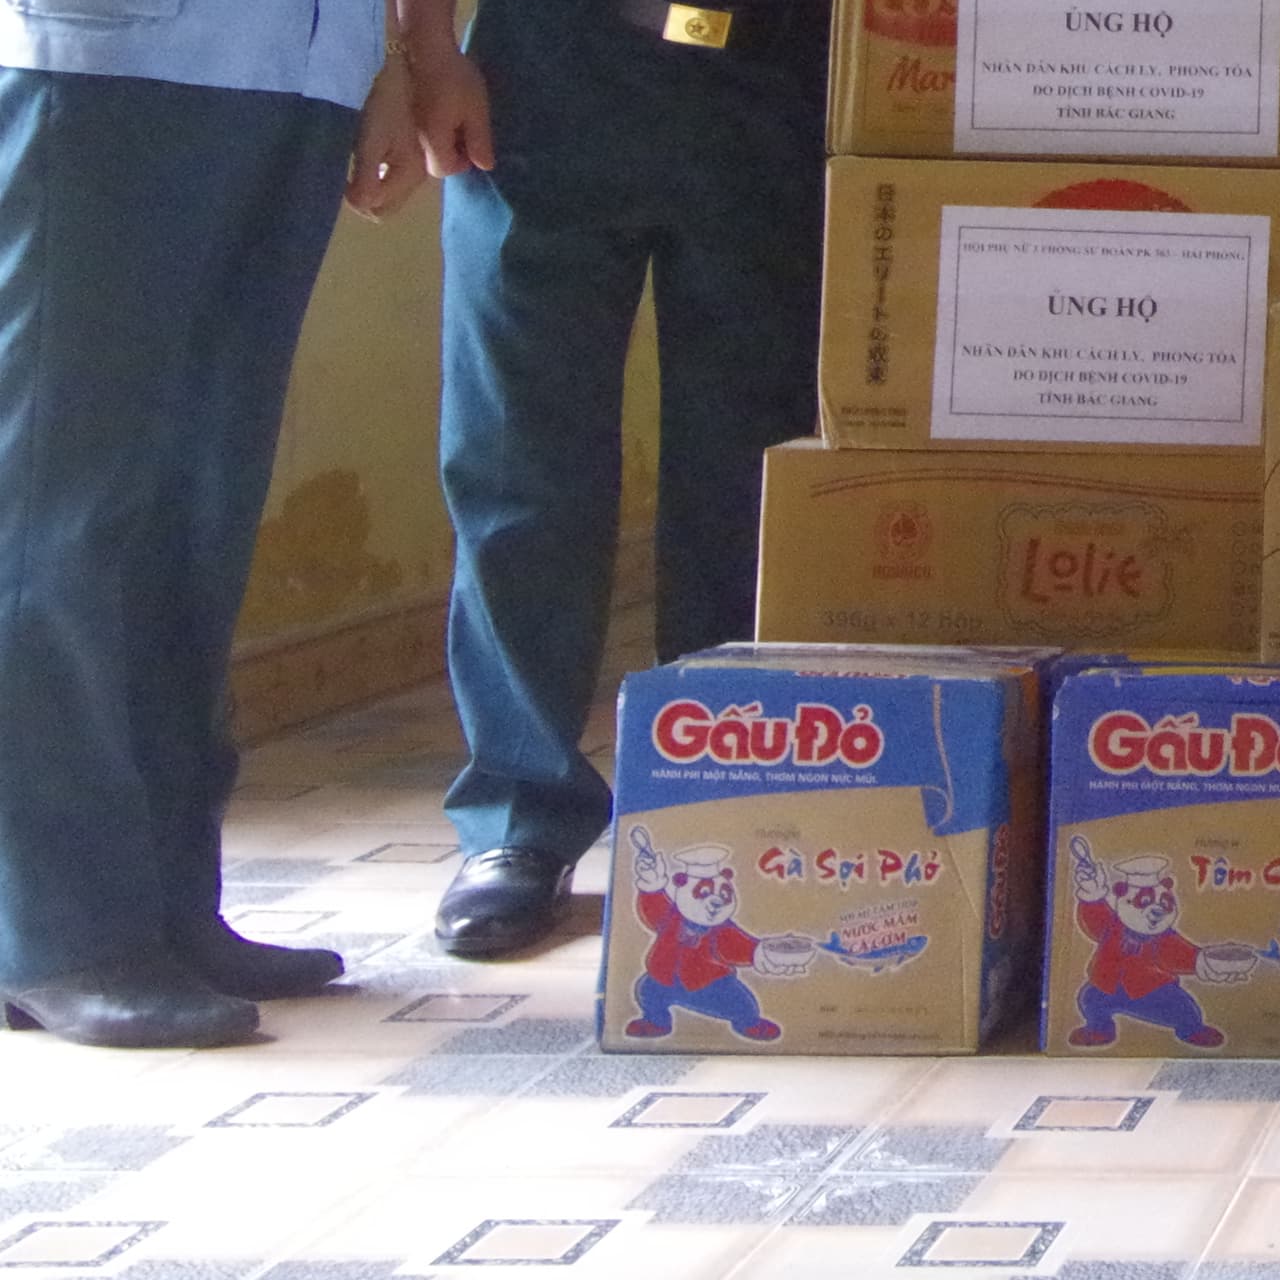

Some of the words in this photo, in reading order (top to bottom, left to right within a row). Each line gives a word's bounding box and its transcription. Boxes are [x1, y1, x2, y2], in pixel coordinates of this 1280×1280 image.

[1064, 5, 1124, 32] ỦNG
[1132, 8, 1173, 37] HỘ
[1046, 288, 1108, 317] ỦNG
[1115, 293, 1158, 323] HỘ
[758, 847, 803, 880] Gà
[1191, 856, 1252, 887] Tôm
